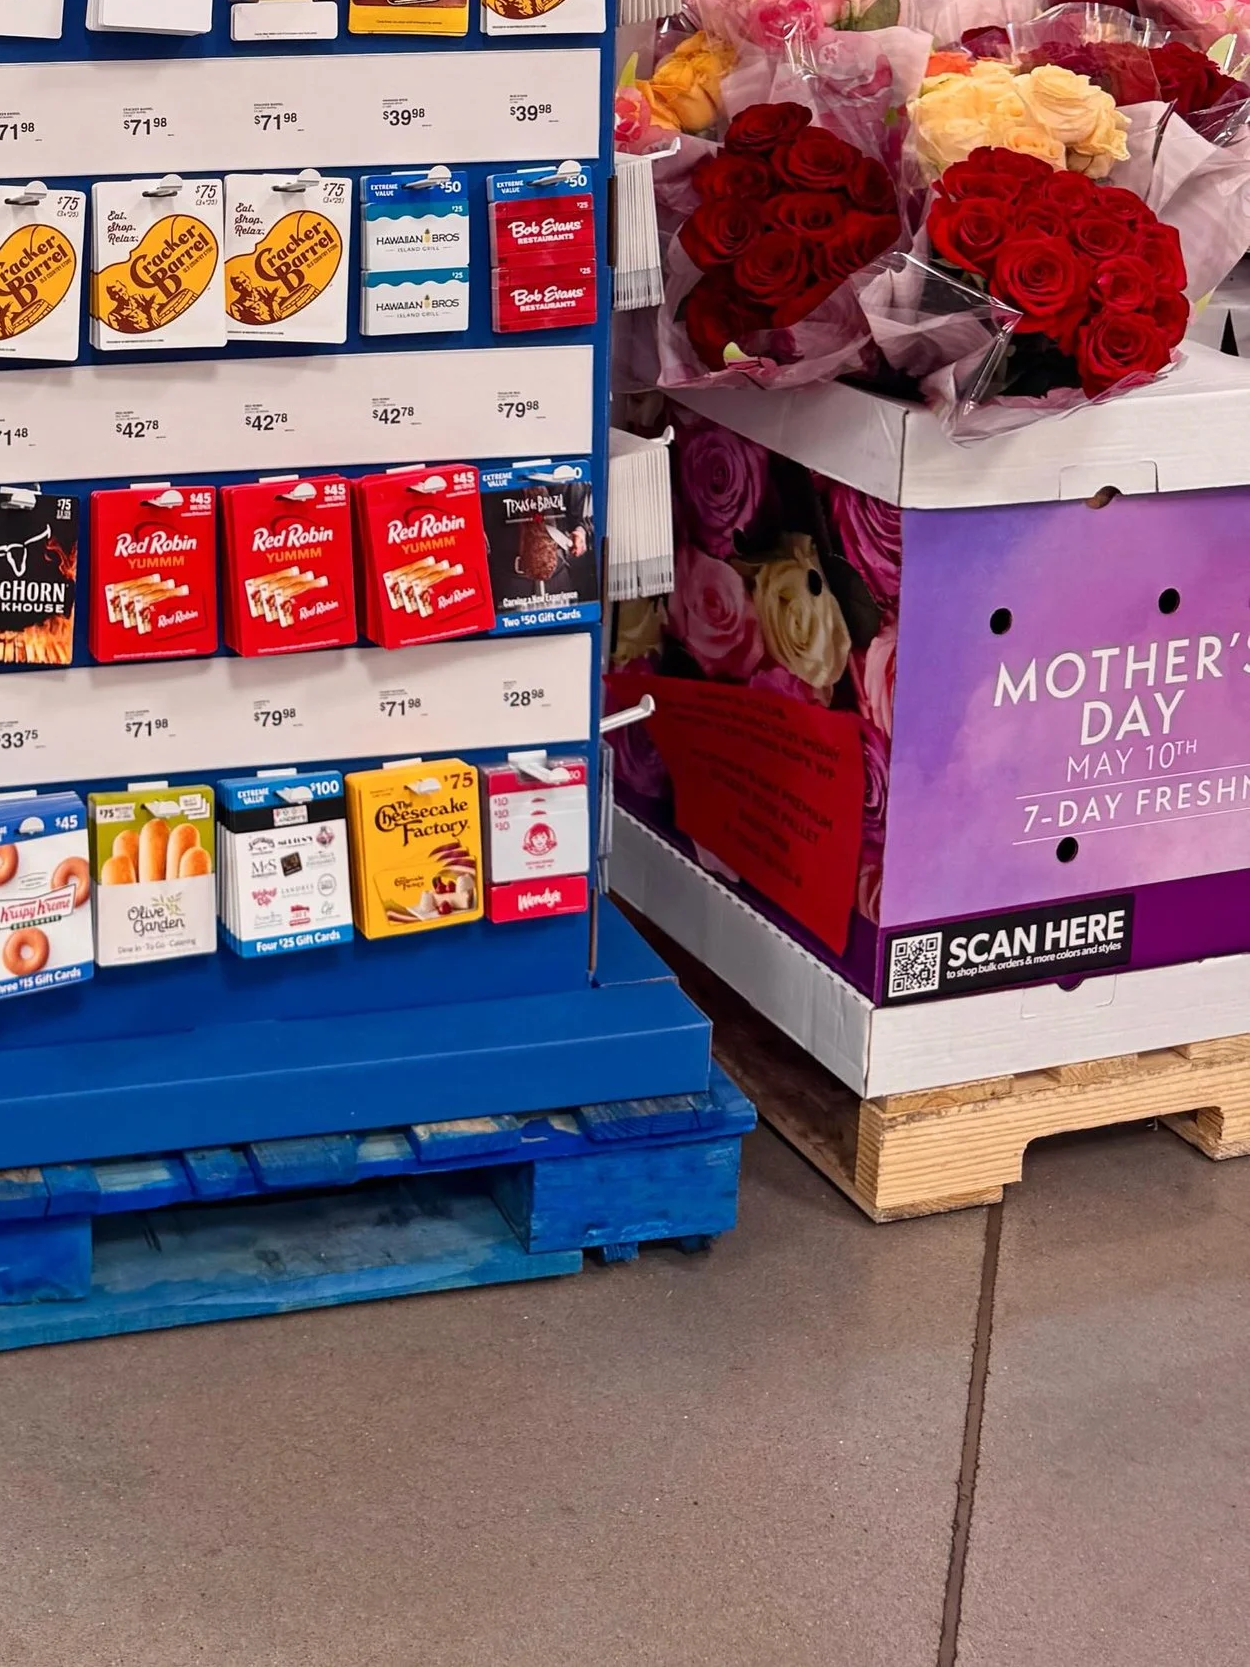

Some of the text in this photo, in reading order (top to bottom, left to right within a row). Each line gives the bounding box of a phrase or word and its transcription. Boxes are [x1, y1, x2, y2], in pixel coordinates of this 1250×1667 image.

[370, 183, 398, 191] EXTREME
[508, 218, 581, 237] Bob Evans
[376, 232, 460, 246] HAWAIIAN BROS
[517, 232, 574, 245] RESTAURANTS
[57, 499, 71, 511] $75
[115, 531, 197, 557] Red Robin
[128, 556, 185, 570] YUMMM
[502, 610, 581, 628] Two $50 Gift Cards
[1079, 690, 1185, 746] DAY
[1066, 738, 1198, 783] MAY 10TH
[310, 781, 339, 795] $100
[443, 773, 473, 788] $75
[397, 801, 413, 810] The
[1023, 792, 1124, 834] 7-DAY
[55, 815, 78, 829] $45
[375, 800, 468, 833] Cheesecake
[402, 819, 471, 846] Factory
[0, 892, 71, 923] Krispy Kreme
[518, 890, 561, 909] Wendy's
[128, 906, 164, 922] Olive
[133, 918, 184, 937] Garden
[256, 930, 340, 952] Four $25 Gift Cards
[948, 909, 1125, 968] SCAN HERE
[947, 941, 1122, 981] to shop bulk orders & more colors and styles
